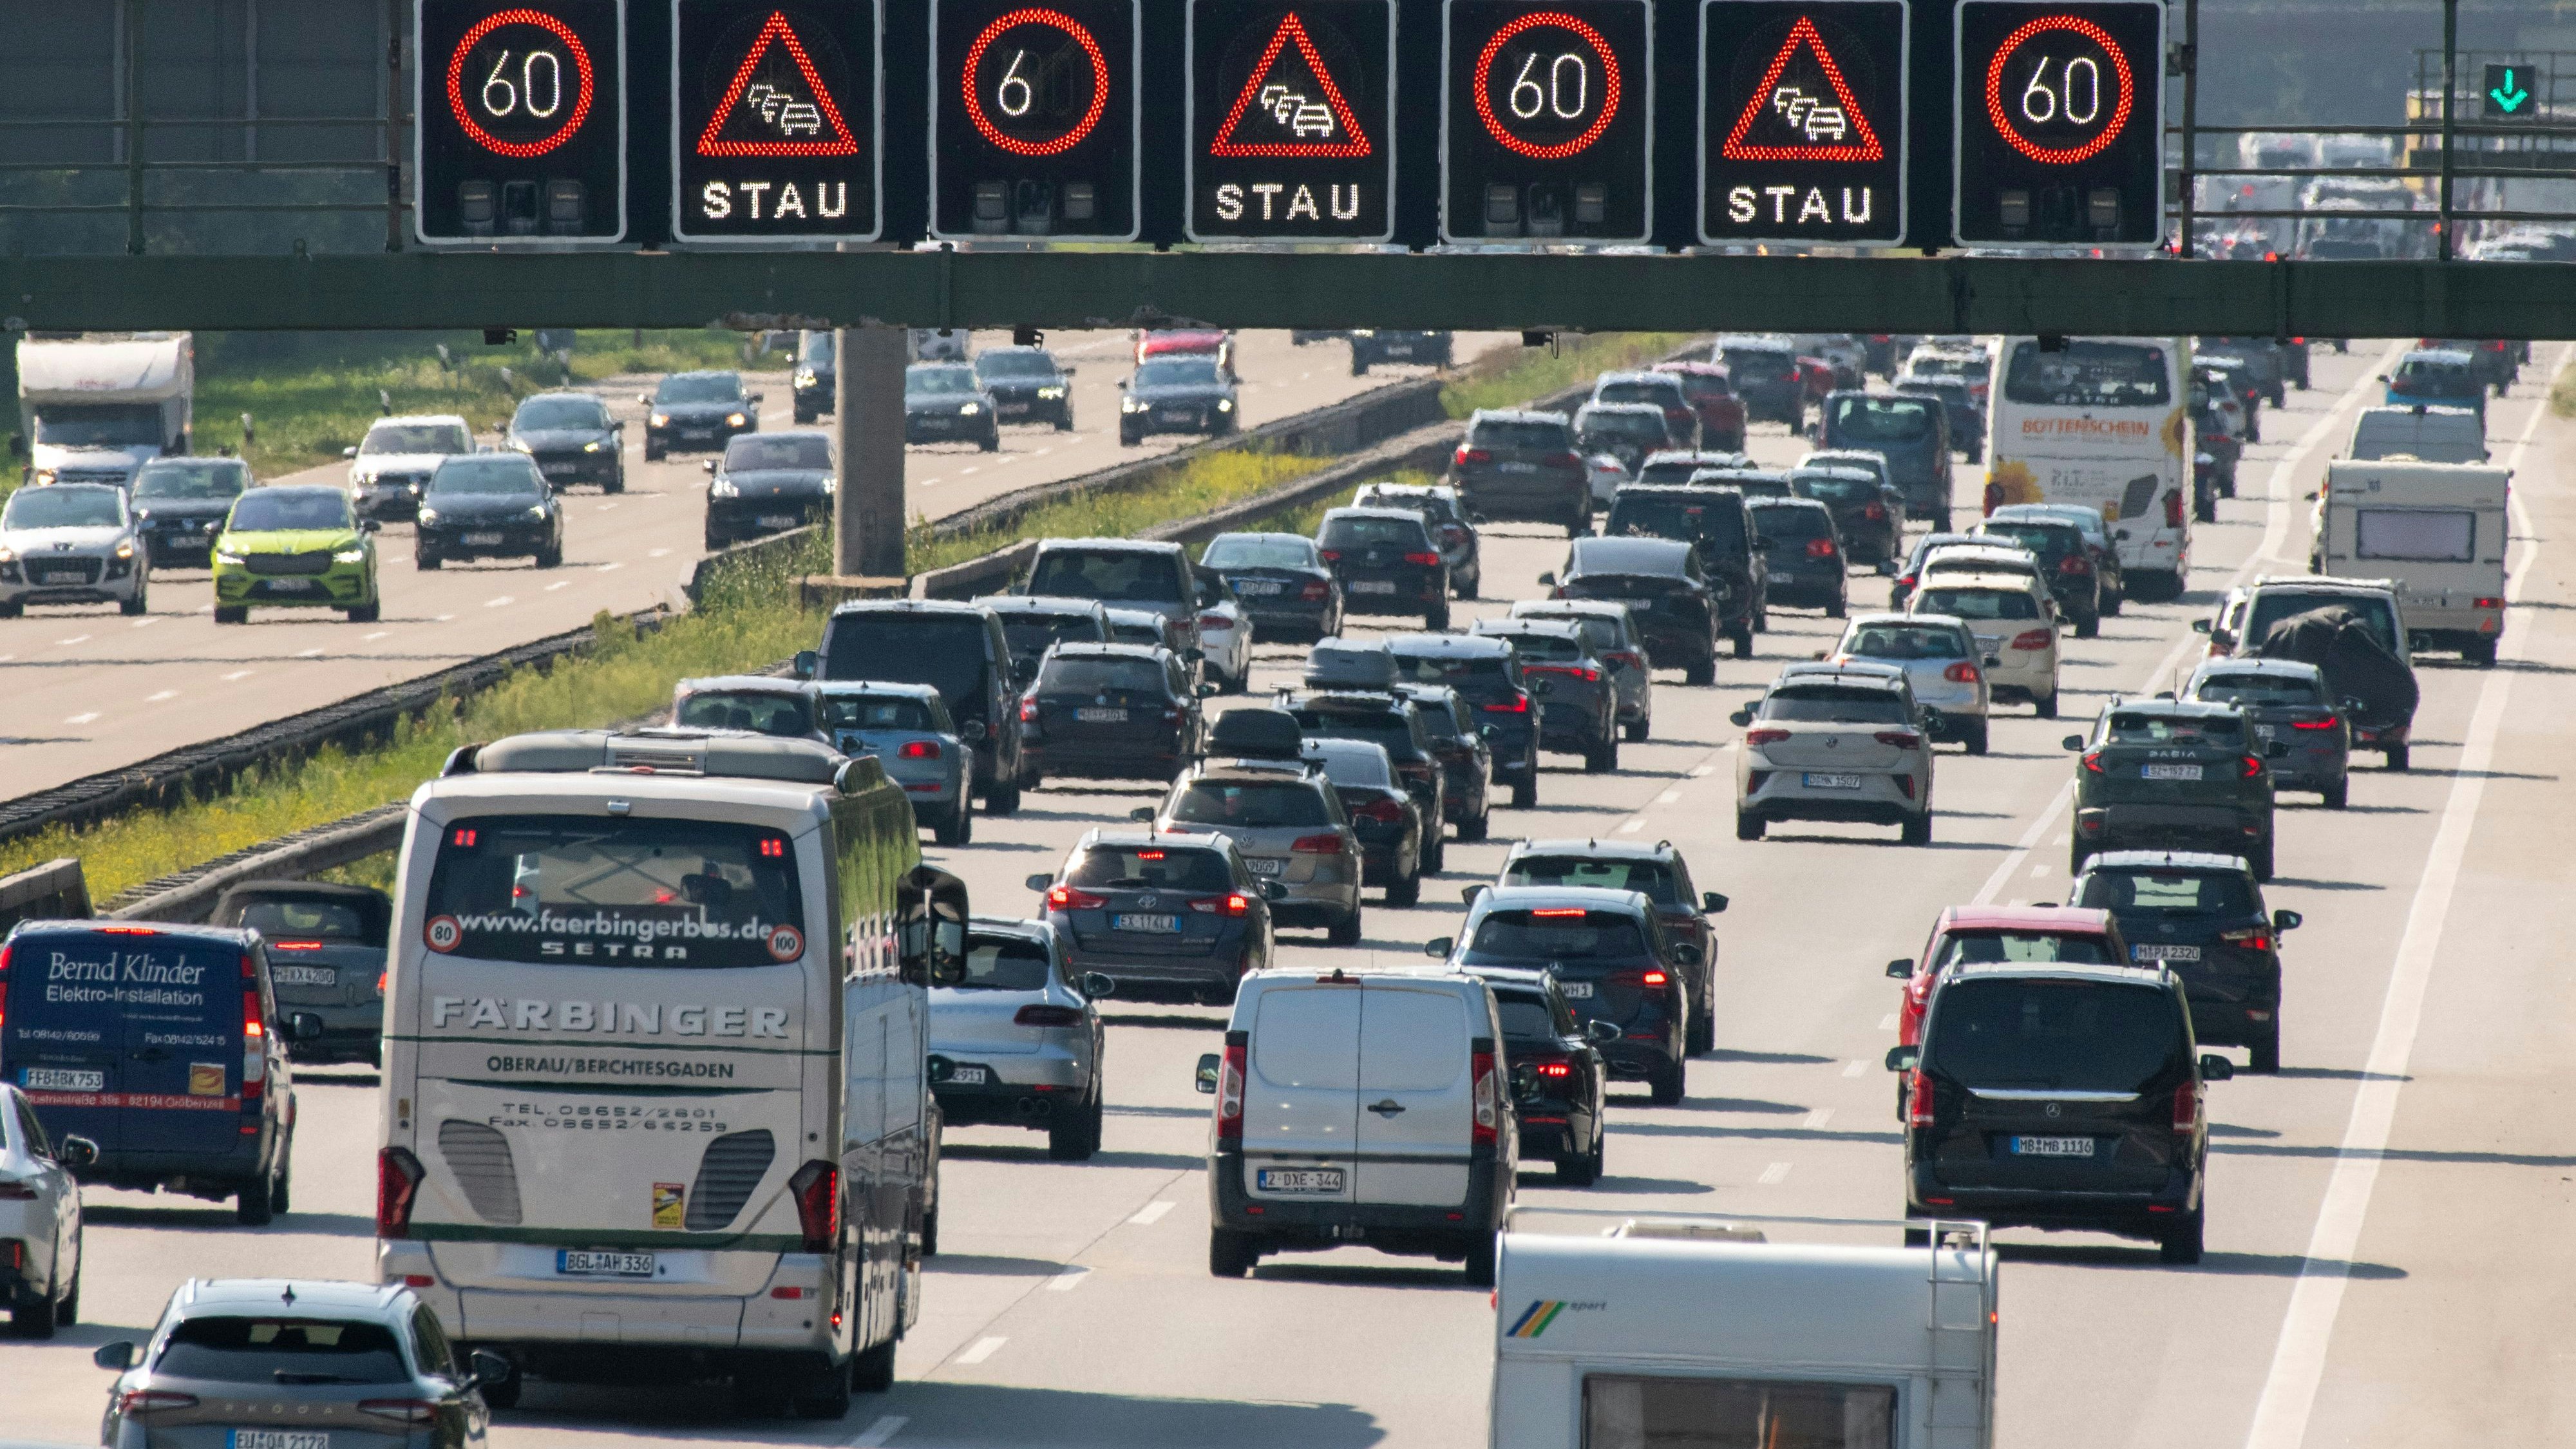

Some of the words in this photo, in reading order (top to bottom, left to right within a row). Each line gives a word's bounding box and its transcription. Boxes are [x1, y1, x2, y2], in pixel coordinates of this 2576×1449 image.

[482, 50, 560, 118] 60
[998, 49, 1032, 117] 6
[1511, 52, 1586, 119] 60
[2022, 56, 2099, 124] 60
[703, 181, 846, 219] STAU
[1217, 184, 1358, 220] STAU
[1728, 185, 1870, 223] STAU
[2148, 750, 2196, 758] DACIA
[434, 925, 451, 942] 80
[455, 908, 773, 943] www.faerbingerbus.de
[540, 941, 687, 959] SETRA
[773, 936, 796, 952] 100
[48, 951, 118, 981] Bernd
[121, 953, 206, 985] Klinder
[46, 985, 204, 1005] Elektro-Installation
[433, 996, 790, 1039] FÄRBINGER
[28, 1070, 52, 1086] FFB
[78, 1072, 102, 1088] 753
[486, 1055, 734, 1079] OBERAU/BERCHTESGADEN
[502, 1103, 551, 1115] TEL.
[2020, 1139, 2035, 1152] MB
[2061, 1140, 2092, 1153] 1116
[567, 1254, 594, 1269] BGL
[623, 1255, 650, 1272] 336
